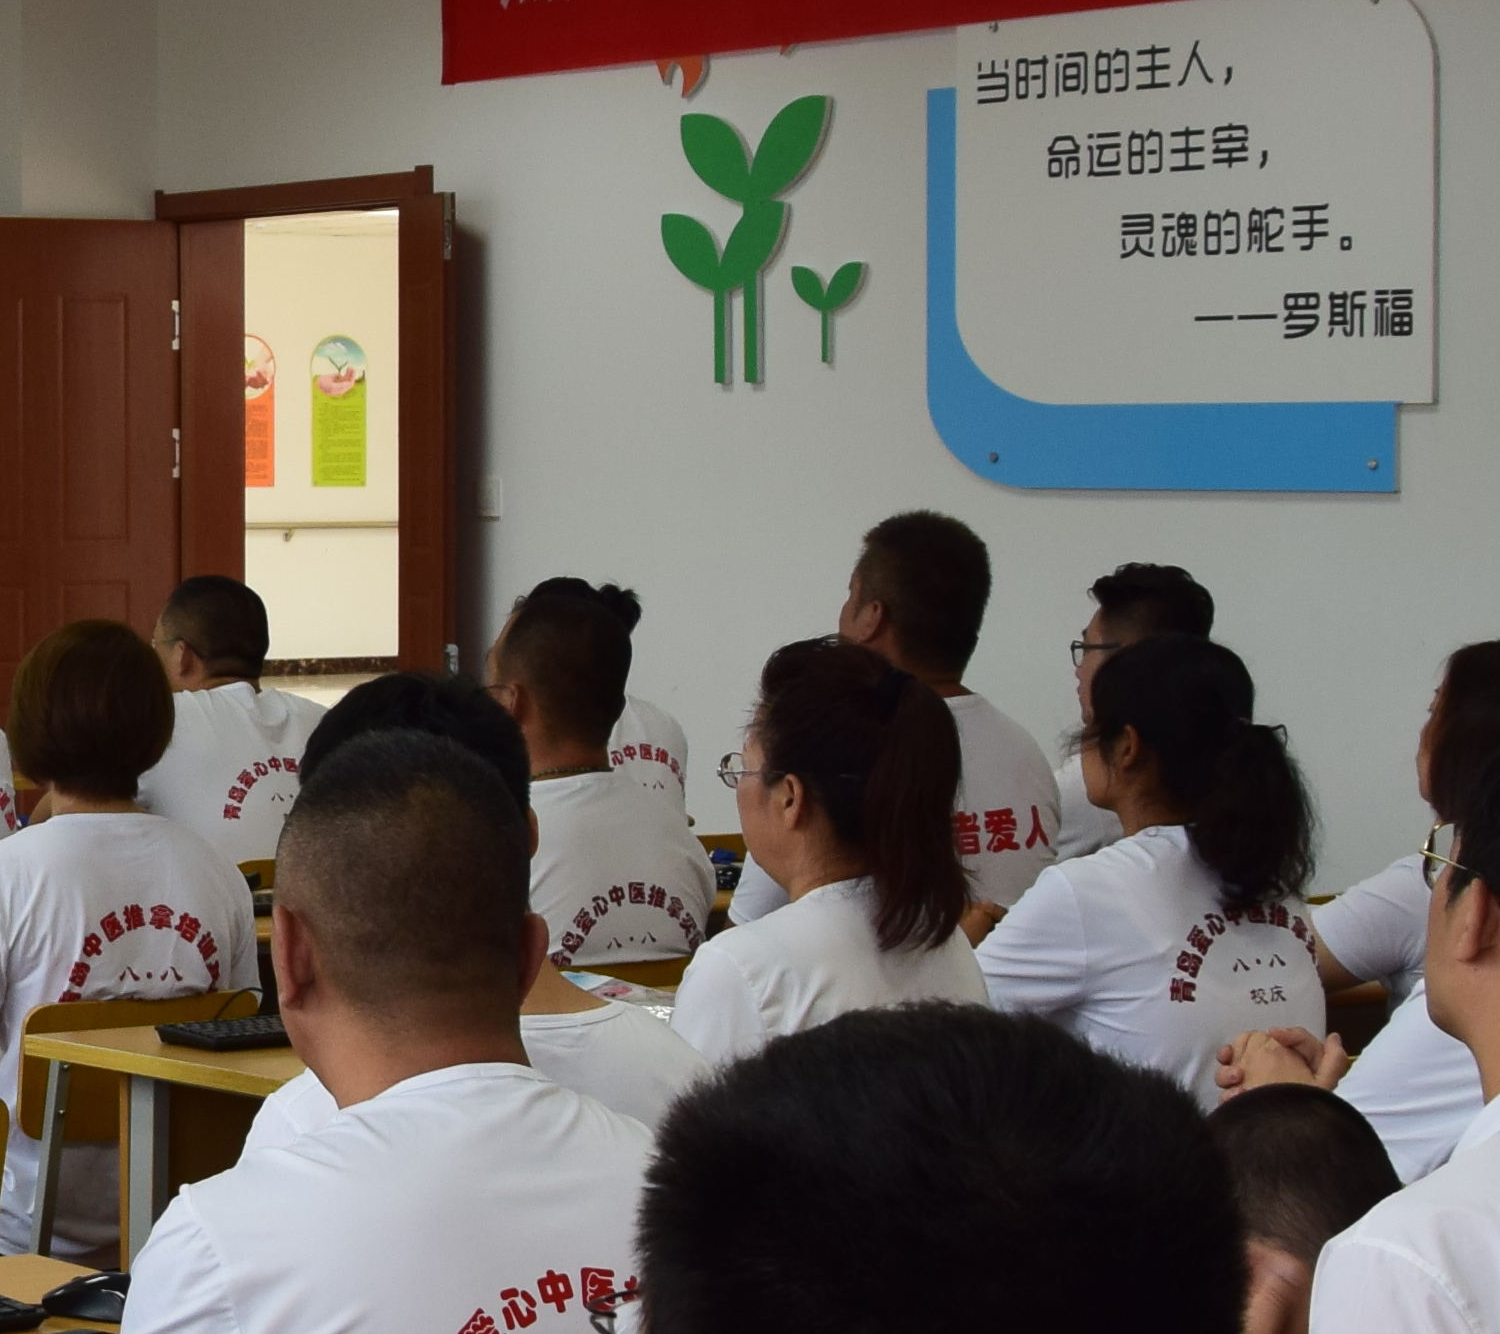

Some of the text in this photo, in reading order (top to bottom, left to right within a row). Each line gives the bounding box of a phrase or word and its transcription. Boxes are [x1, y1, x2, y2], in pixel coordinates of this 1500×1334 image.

[977, 40, 1234, 105] 当时间的主人，
[1047, 122, 1270, 179] 命运的主宰，
[1120, 203, 1352, 259] 灵魂的舵手。
